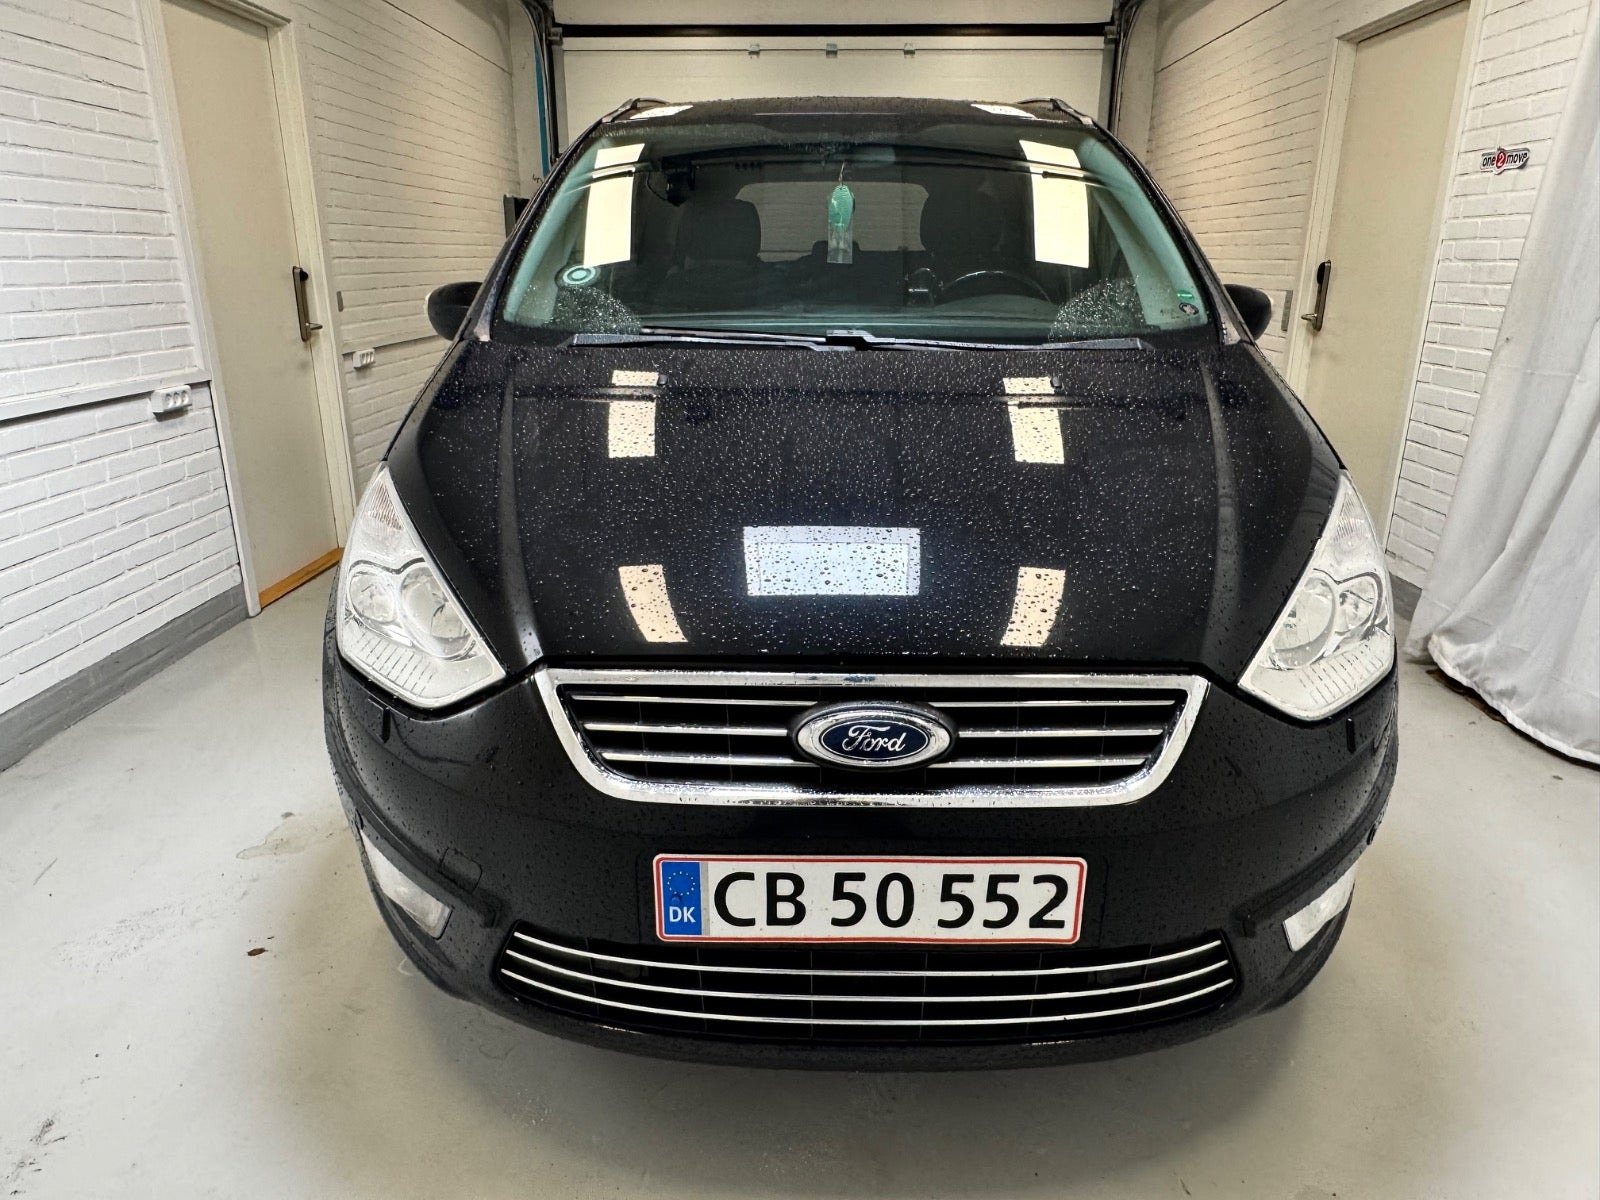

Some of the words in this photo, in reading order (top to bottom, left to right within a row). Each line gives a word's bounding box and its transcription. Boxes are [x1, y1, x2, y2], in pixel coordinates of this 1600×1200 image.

[842, 724, 907, 751] Ford
[713, 871, 807, 927] CB
[830, 872, 915, 929] 50
[937, 873, 1069, 929] 552
[669, 906, 696, 924] DK
